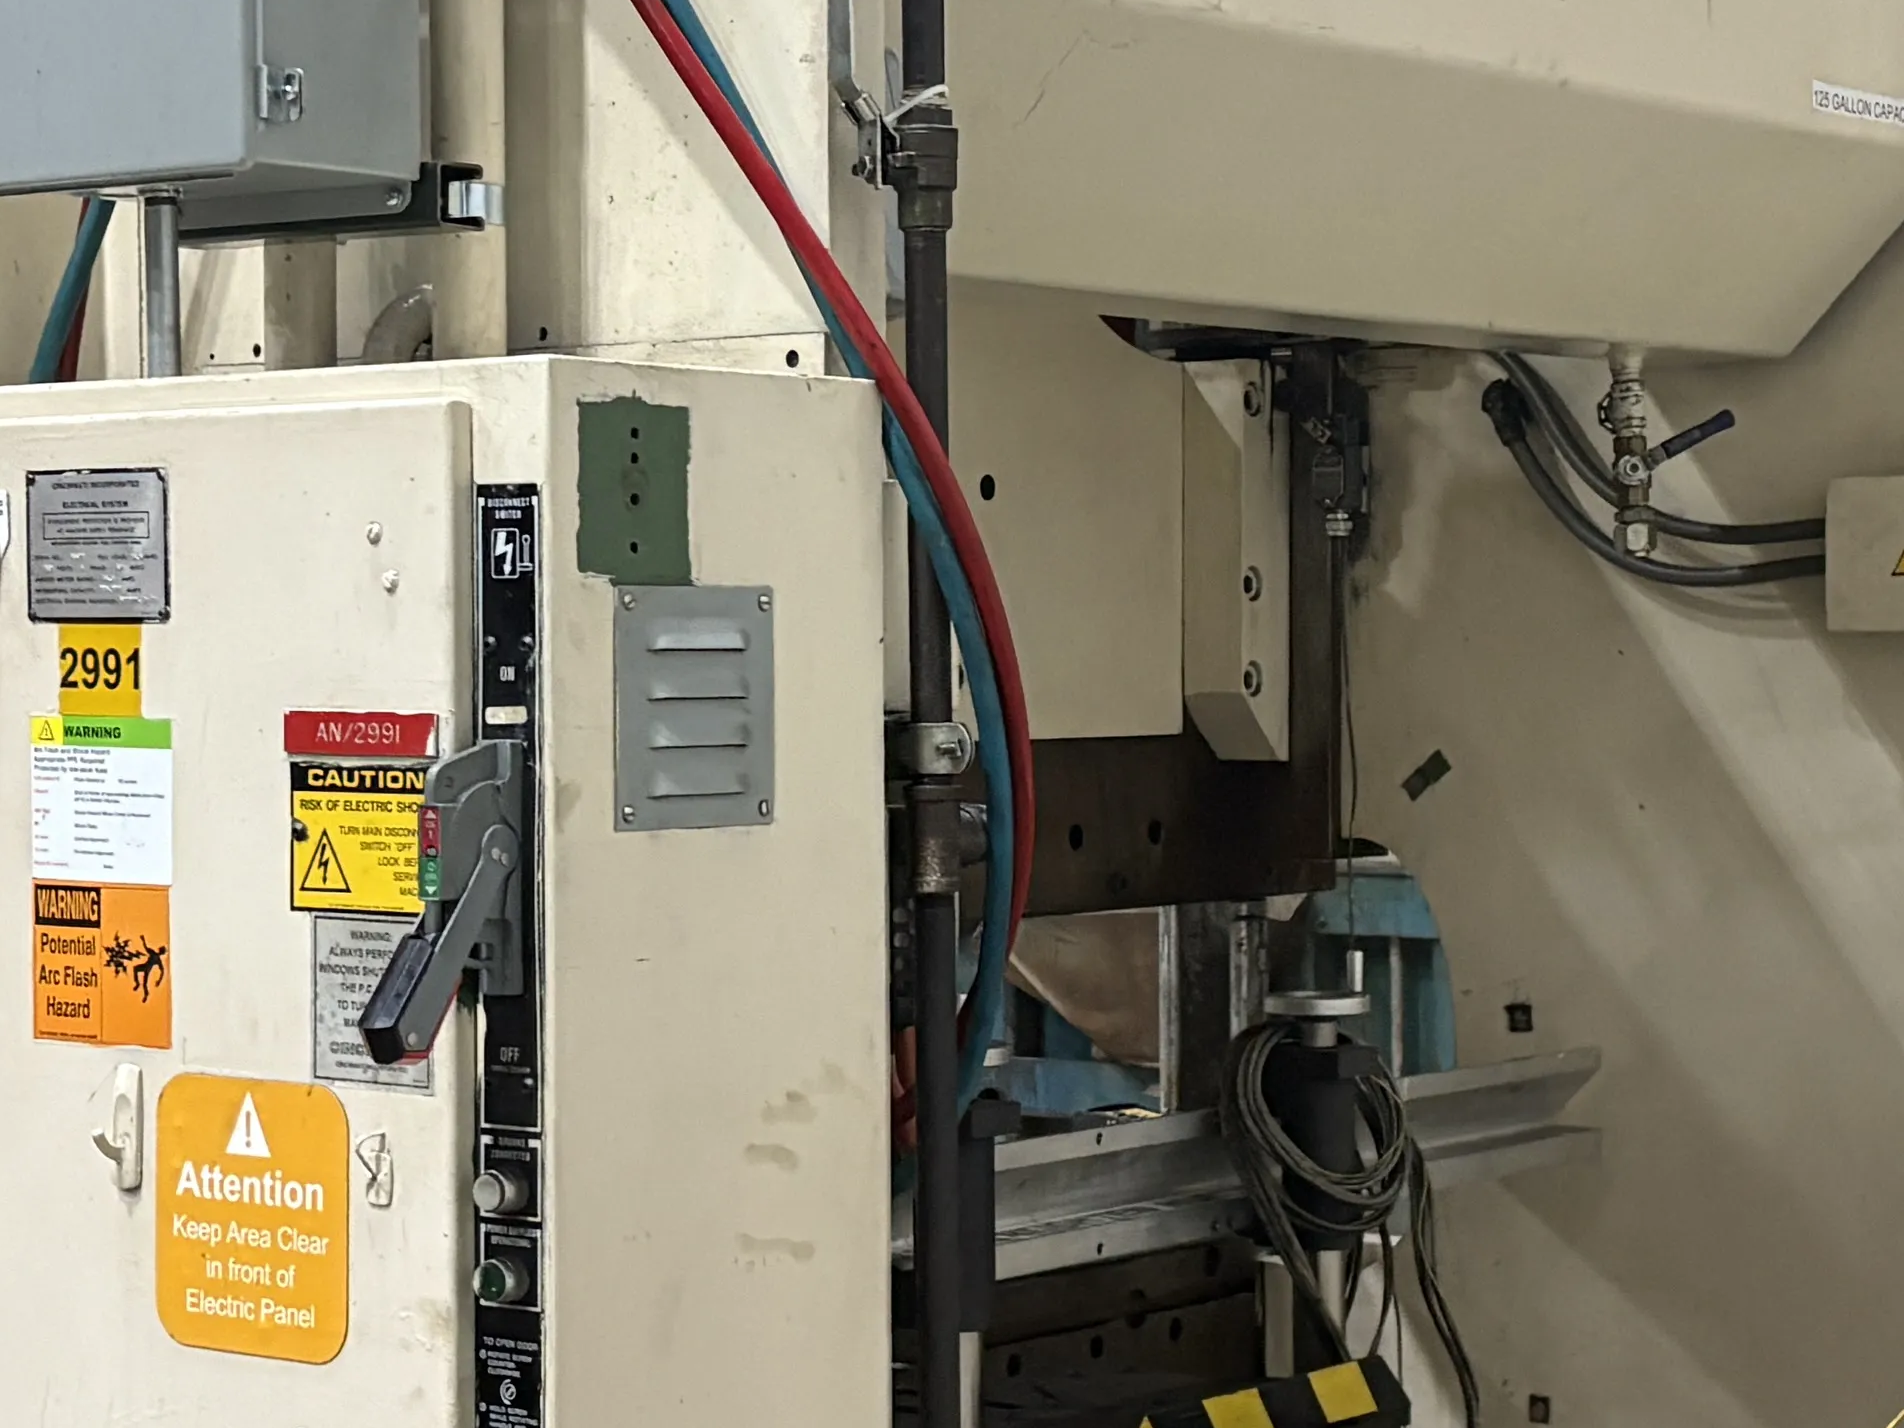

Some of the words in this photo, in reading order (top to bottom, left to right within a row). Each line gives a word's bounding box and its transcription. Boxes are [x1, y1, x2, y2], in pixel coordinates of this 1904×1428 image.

[1814, 90, 1830, 109] 125
[1832, 93, 1872, 117] GALLON
[60, 646, 140, 690] 2991
[499, 665, 516, 682] ON
[64, 725, 122, 739] WARNING
[315, 722, 400, 744] AN/2991
[307, 768, 424, 789] CAUTION
[300, 799, 323, 811] RISK
[326, 800, 340, 811] OF
[343, 801, 393, 813] ELECTRIC
[397, 802, 419, 813] SHO
[339, 825, 360, 836] TURN
[362, 826, 383, 837] MAIN
[378, 857, 400, 866] LOCK
[399, 887, 418, 897] MAC
[37, 888, 98, 921] WARNING
[41, 933, 96, 956] Potential
[329, 946, 364, 959] ALWAYS
[365, 949, 395, 960] PERFO
[39, 964, 60, 986] Arc
[64, 965, 98, 988] Flash
[46, 995, 91, 1019] Hazard
[337, 1000, 349, 1010] TO
[176, 1160, 324, 1212] Attention
[172, 1213, 222, 1246] Keep
[226, 1221, 272, 1249] Area
[277, 1226, 329, 1256] Clear
[205, 1255, 223, 1278] in
[228, 1257, 272, 1286] front
[276, 1264, 296, 1290] of
[185, 1288, 255, 1321] Electric
[260, 1298, 315, 1329] Panel
